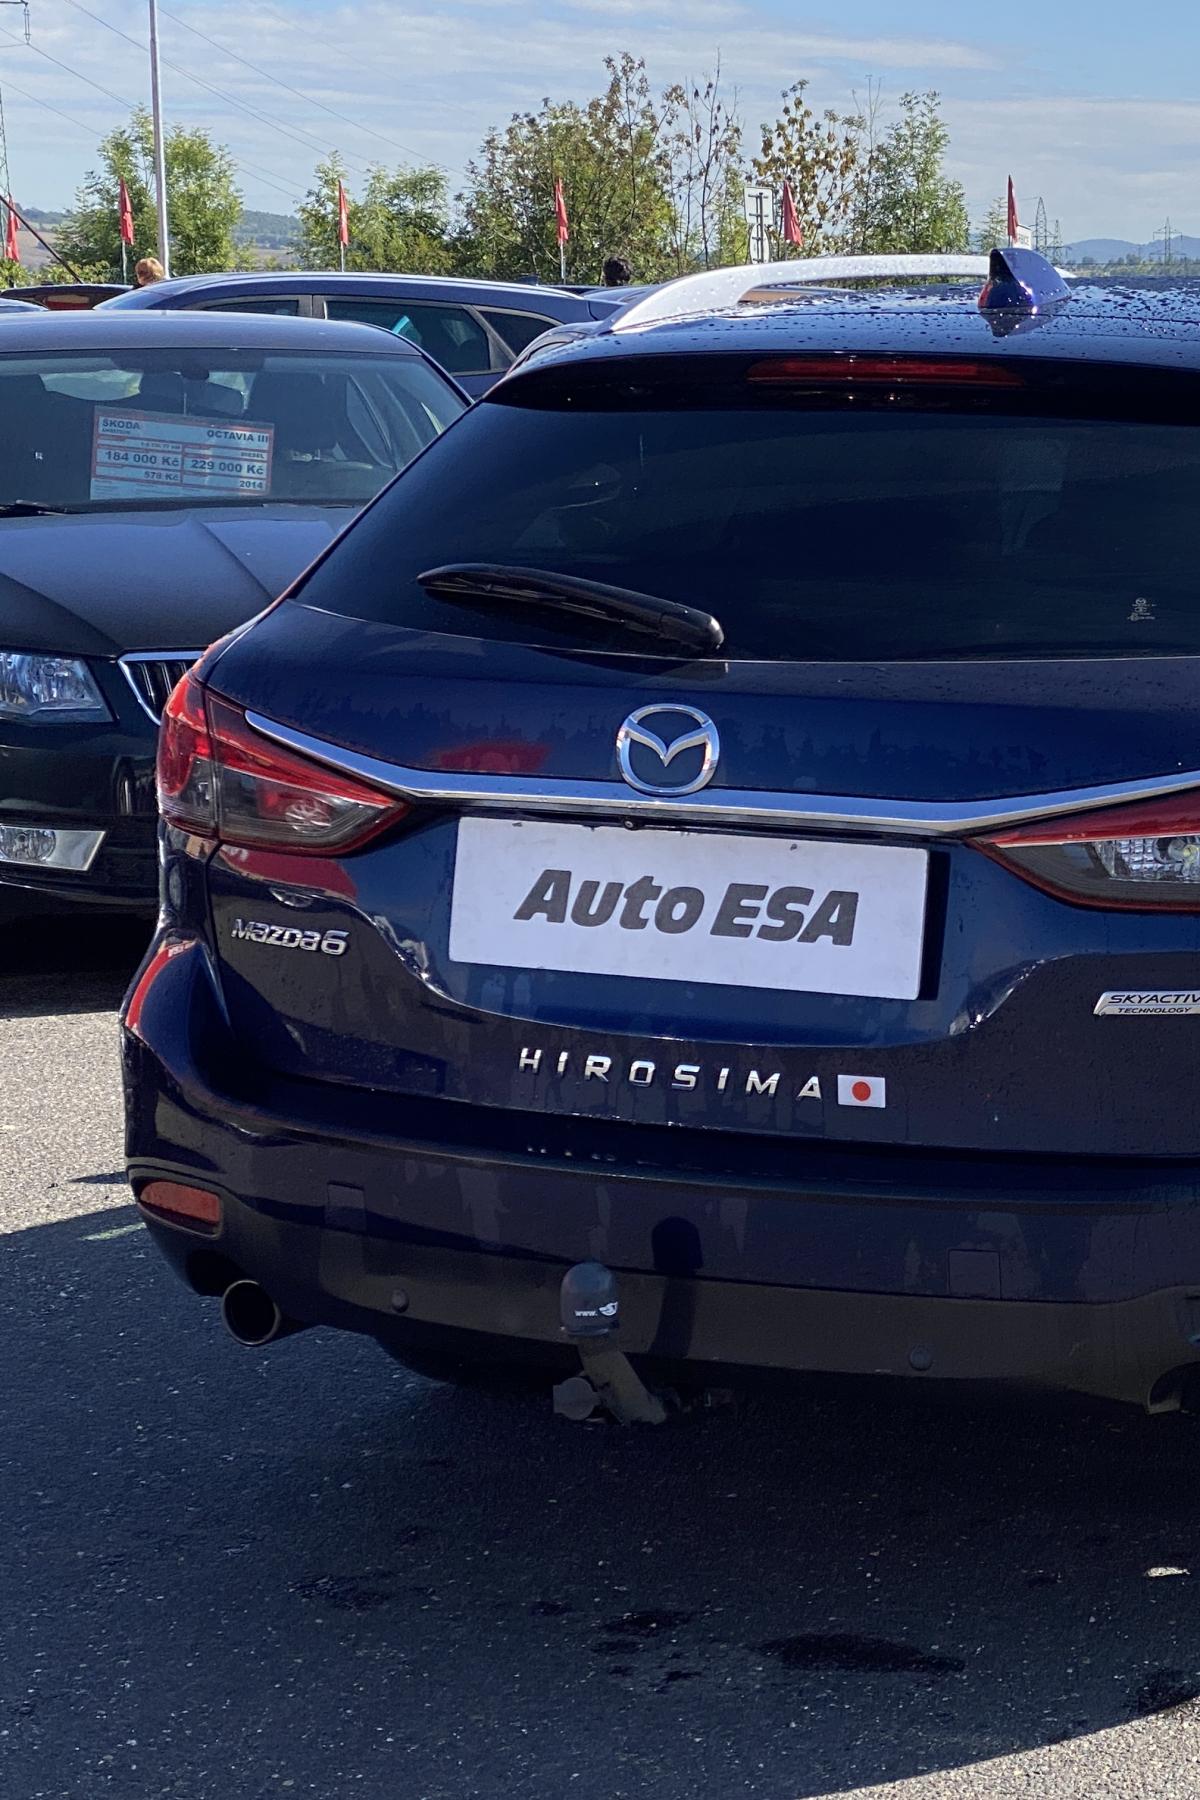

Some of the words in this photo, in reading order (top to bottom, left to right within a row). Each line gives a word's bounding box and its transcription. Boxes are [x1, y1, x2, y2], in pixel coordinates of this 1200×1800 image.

[207, 430, 254, 441] OCTAVIA
[105, 450, 129, 461] 184
[133, 453, 157, 464] 000
[191, 460, 215, 470] 229
[219, 462, 243, 473] 000
[247, 464, 264, 475] Kč
[239, 480, 263, 489] 2014
[512, 869, 706, 934] Auto
[709, 883, 860, 947] ESA
[518, 1046, 824, 1101] HIROSIMA
